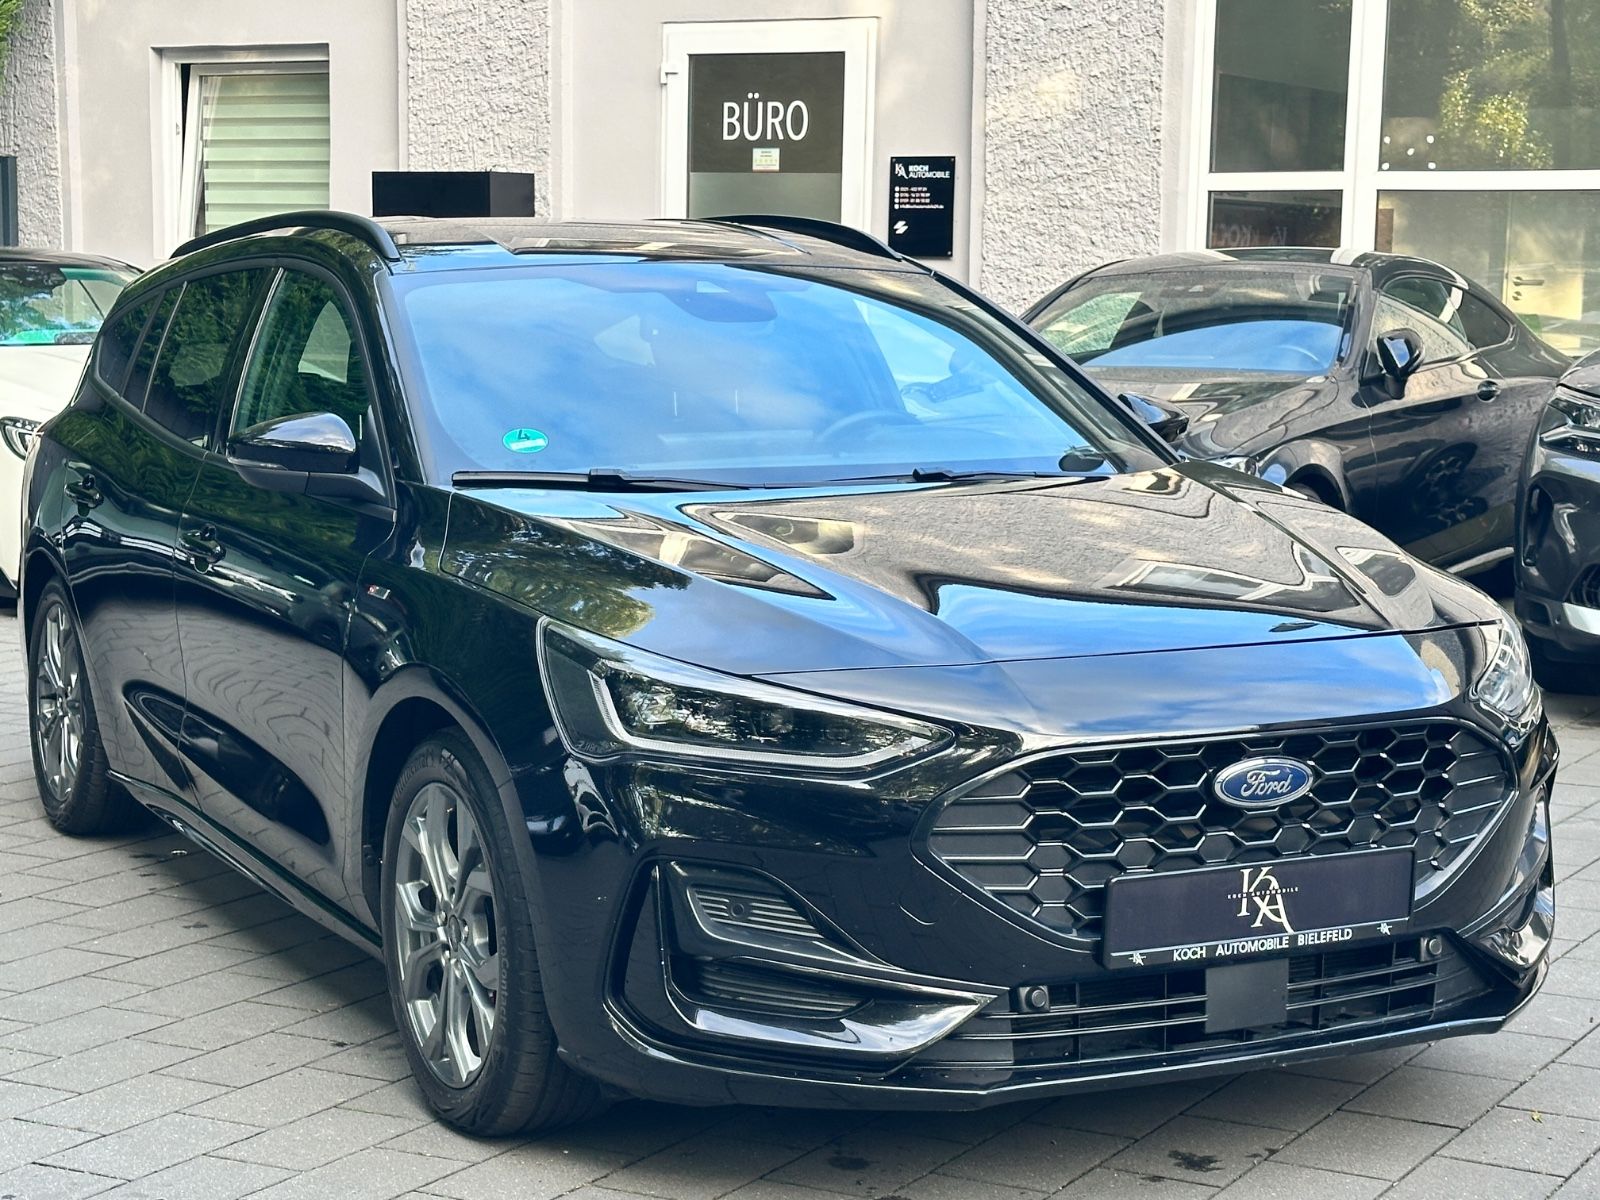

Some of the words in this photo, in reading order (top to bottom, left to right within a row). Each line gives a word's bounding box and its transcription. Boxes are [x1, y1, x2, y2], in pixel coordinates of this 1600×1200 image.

[722, 92, 809, 141] BÜRO
[908, 171, 951, 179] AUTOMOBILE
[517, 429, 530, 441] 4
[1240, 769, 1294, 797] Ford
[1251, 886, 1299, 897] AUTOMOBILE
[1173, 946, 1207, 962] KOCH
[1215, 934, 1290, 957] AUTOMOBILE
[1297, 927, 1353, 946] BIELEFELD
